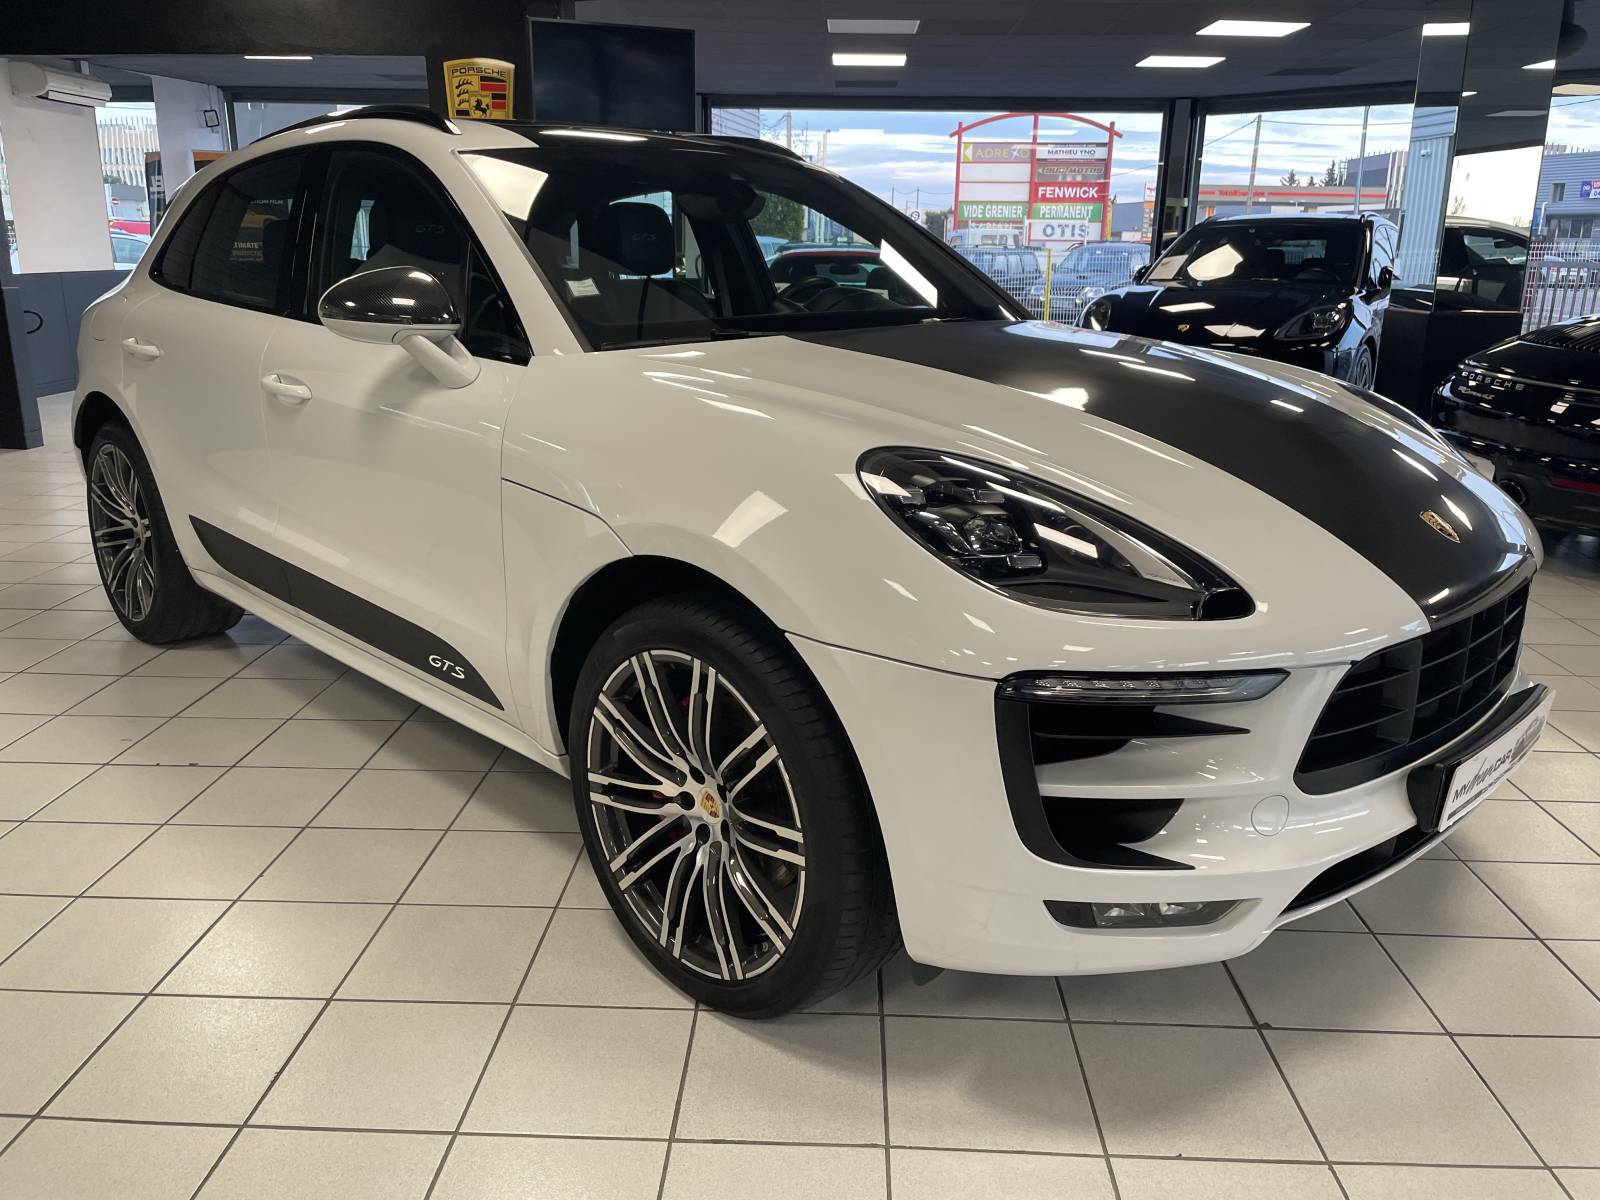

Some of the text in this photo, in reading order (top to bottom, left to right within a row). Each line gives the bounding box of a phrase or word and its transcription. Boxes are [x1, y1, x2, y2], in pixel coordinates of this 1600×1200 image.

[451, 66, 507, 79] PORSCHE
[1038, 186, 1099, 198] FENWICK
[963, 204, 1023, 218] VIDE GRENIER
[1040, 204, 1094, 218] PERMANENT
[1042, 223, 1091, 238] OTIS
[1461, 371, 1525, 391] PORSCHE
[429, 655, 465, 679] GTS
